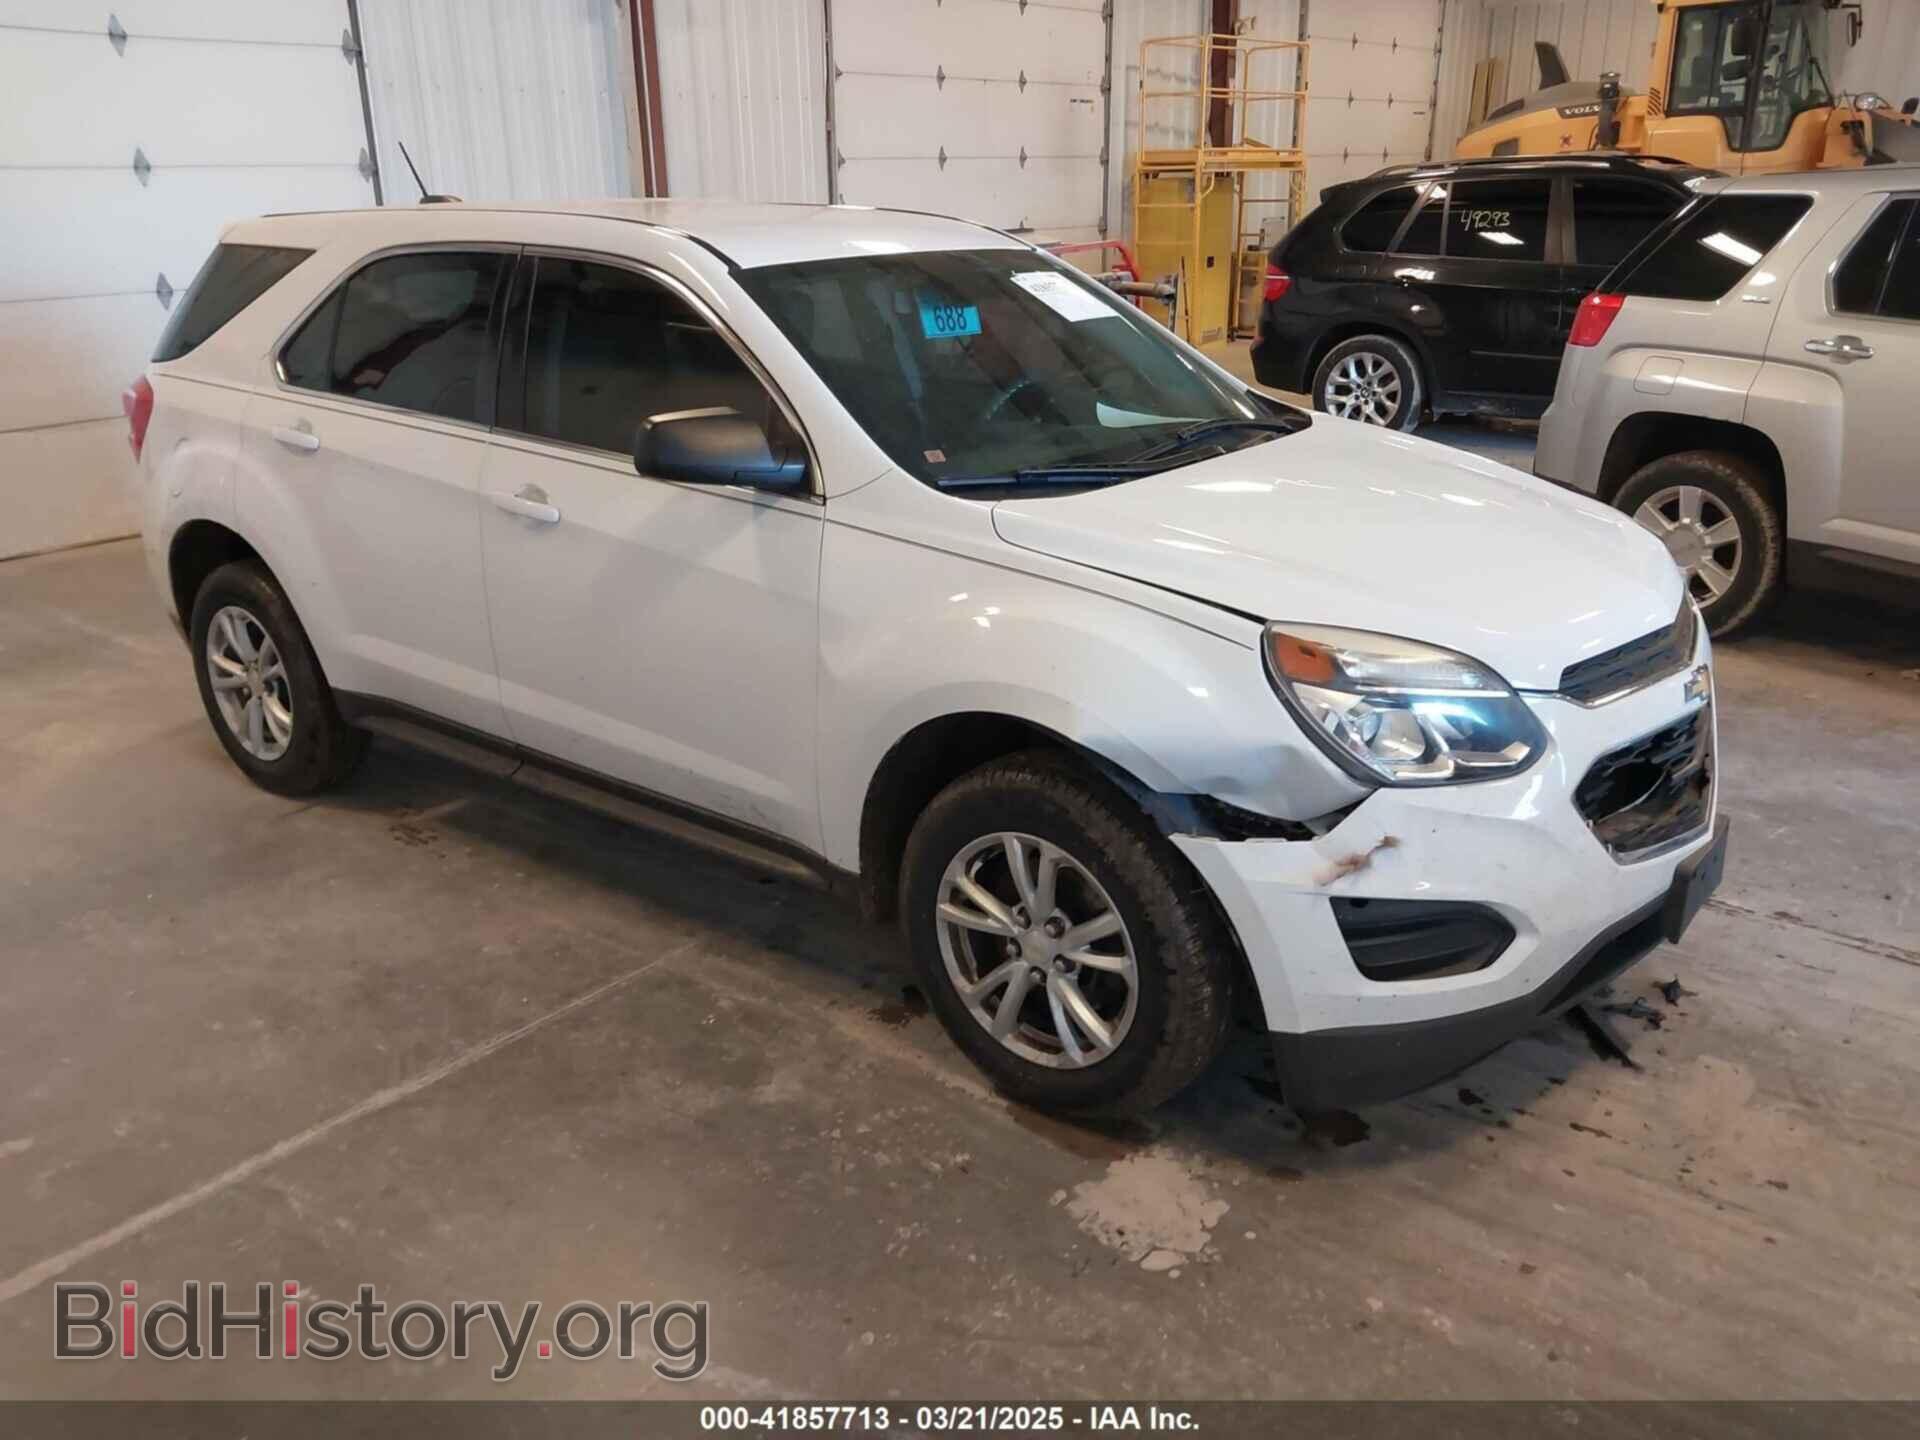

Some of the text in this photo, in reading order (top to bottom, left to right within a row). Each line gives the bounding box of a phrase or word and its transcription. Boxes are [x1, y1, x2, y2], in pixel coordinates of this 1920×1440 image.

[1564, 104, 1601, 115] VOLV
[1460, 209, 1511, 231] 49293
[934, 304, 967, 332] 688
